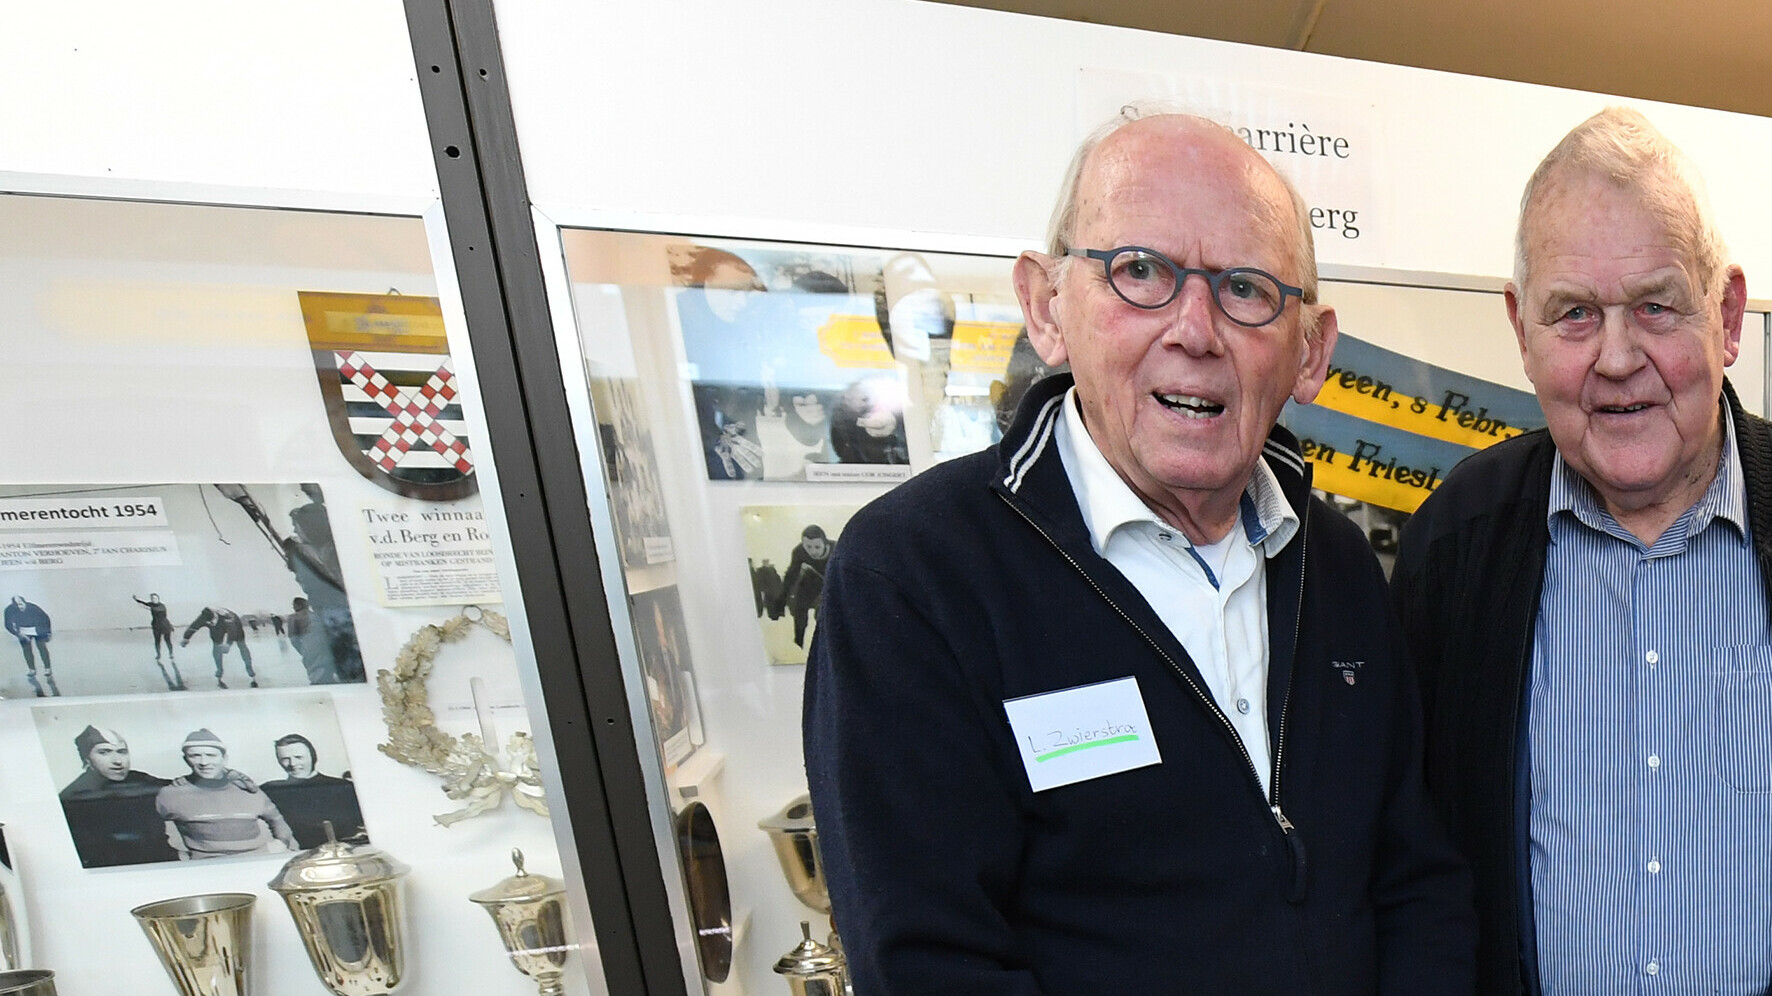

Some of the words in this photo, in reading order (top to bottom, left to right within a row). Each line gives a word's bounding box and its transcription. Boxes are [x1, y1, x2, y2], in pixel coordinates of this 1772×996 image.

[1226, 122, 1351, 159] arrière
[1309, 206, 1361, 239] erg
[1325, 364, 1400, 409] veen,
[1410, 395, 1428, 414] 8
[1435, 389, 1512, 439] Febr.
[1347, 439, 1441, 492] Friesl
[0, 505, 109, 521] merentocht
[114, 504, 158, 518] 1954
[361, 508, 409, 523] Twee
[421, 507, 484, 521] winnaa
[368, 529, 398, 544] v.d.
[399, 528, 440, 548] Berg
[442, 531, 462, 542] en
[464, 526, 490, 541] Ro
